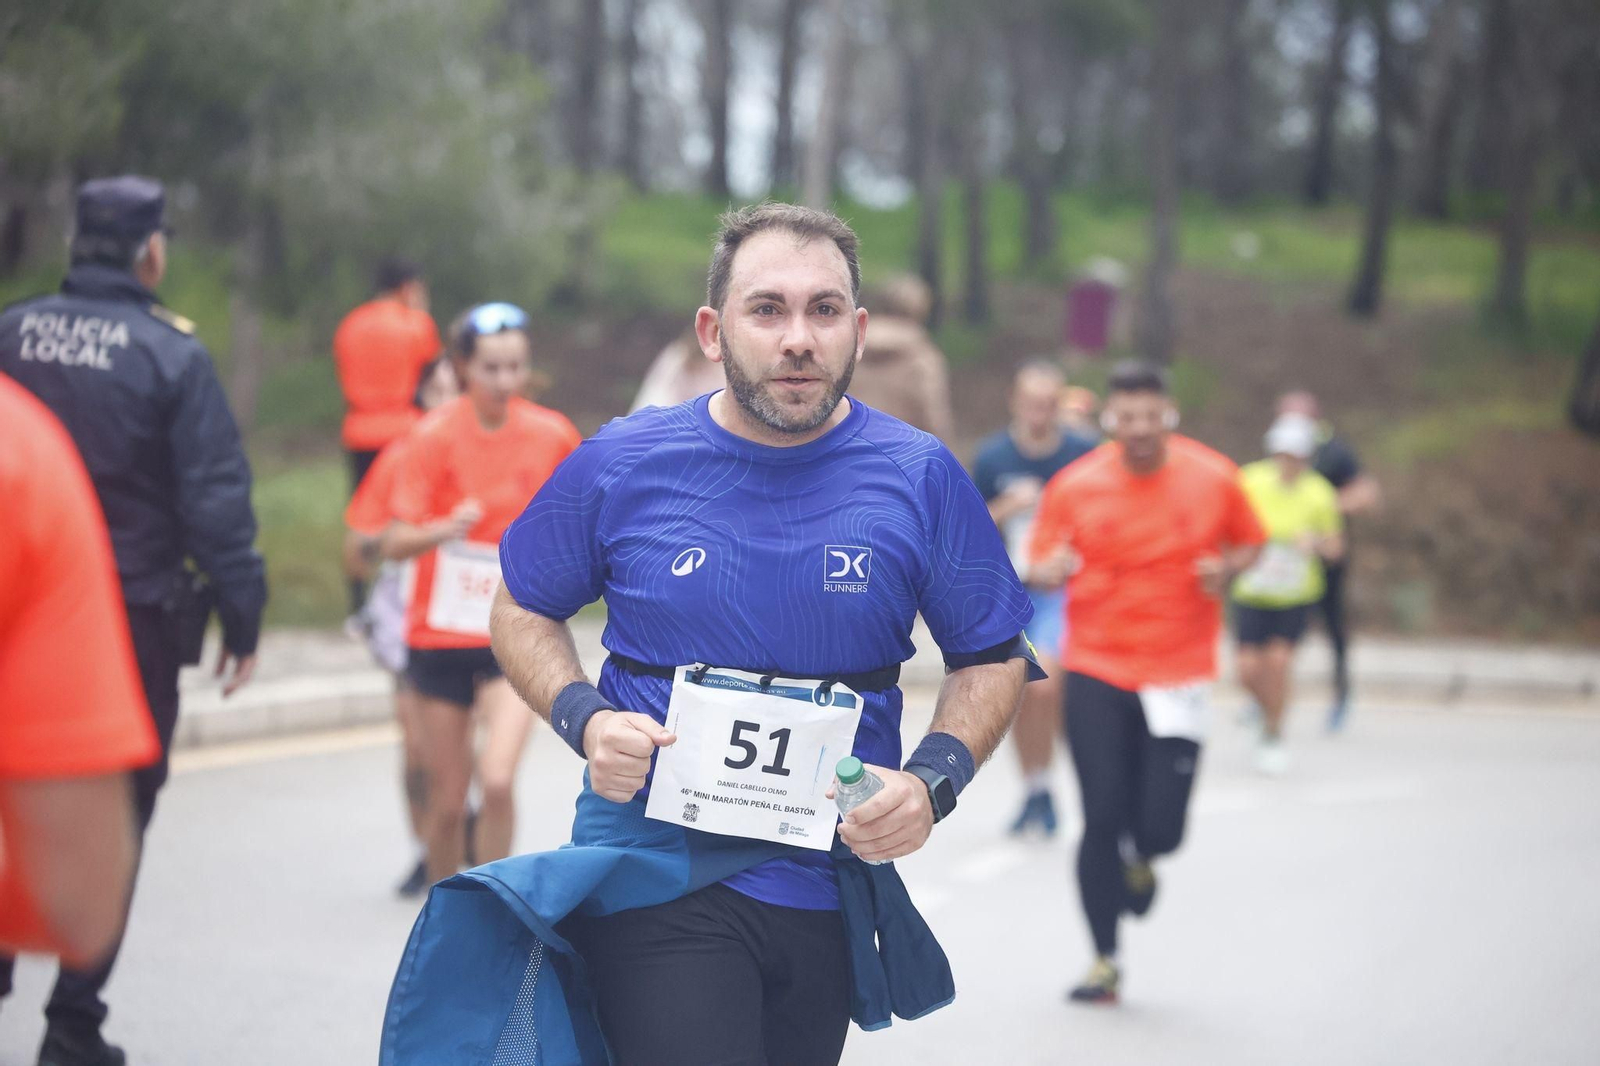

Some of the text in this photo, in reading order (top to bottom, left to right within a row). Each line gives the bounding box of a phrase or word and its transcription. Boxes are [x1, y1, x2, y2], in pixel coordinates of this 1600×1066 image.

[19, 312, 130, 349] POLICIA
[20, 336, 112, 370] LOCAL
[824, 583, 868, 593] RUNNERS
[724, 719, 791, 777] 51
[717, 779, 788, 796] DANIEL CABELLO OLMO
[693, 790, 711, 801] MINI
[711, 792, 750, 807] MARATÓN
[750, 798, 772, 810] PEÑA
[772, 802, 783, 812] EL
[784, 804, 816, 817] BASTÓN
